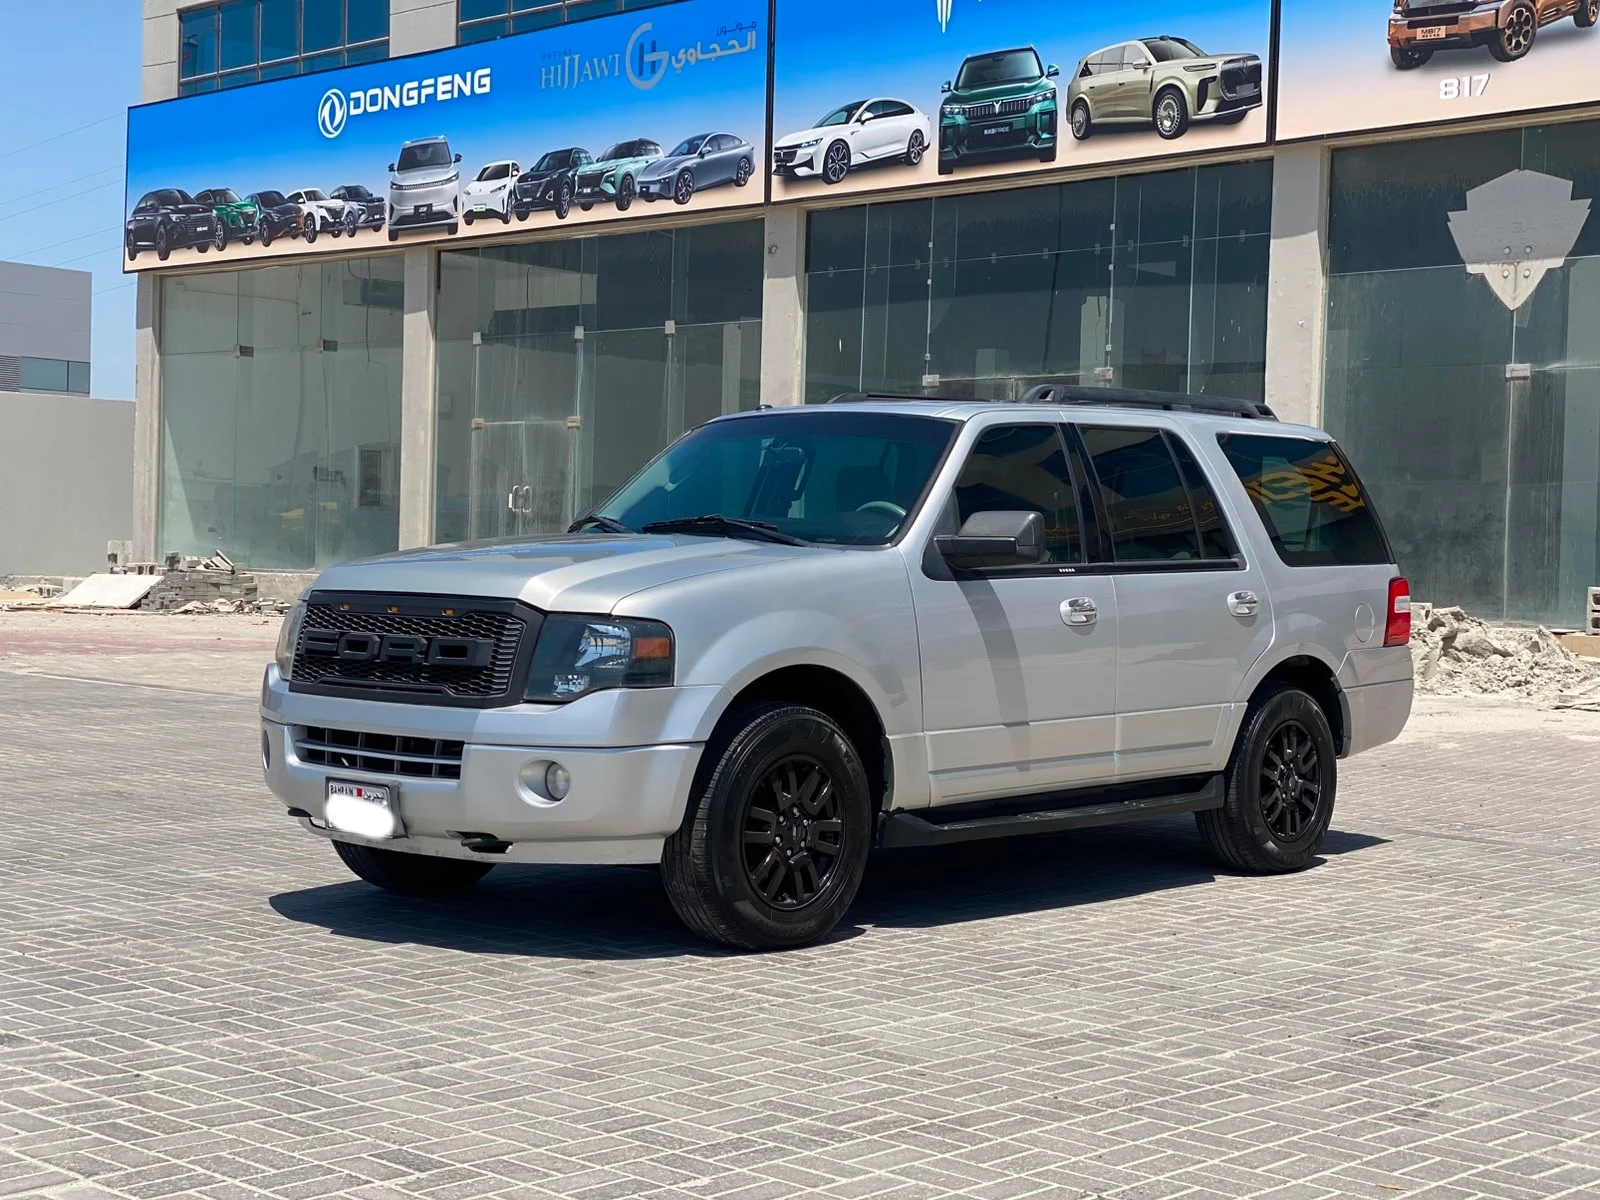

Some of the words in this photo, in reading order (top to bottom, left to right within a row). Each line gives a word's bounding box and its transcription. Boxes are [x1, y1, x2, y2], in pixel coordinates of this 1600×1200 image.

[671, 30, 757, 75] الحجاوي
[349, 67, 491, 116] DONGFENG
[1440, 73, 1490, 100] 817
[301, 628, 495, 667] FORD
[330, 784, 354, 797] BAHRAIN
